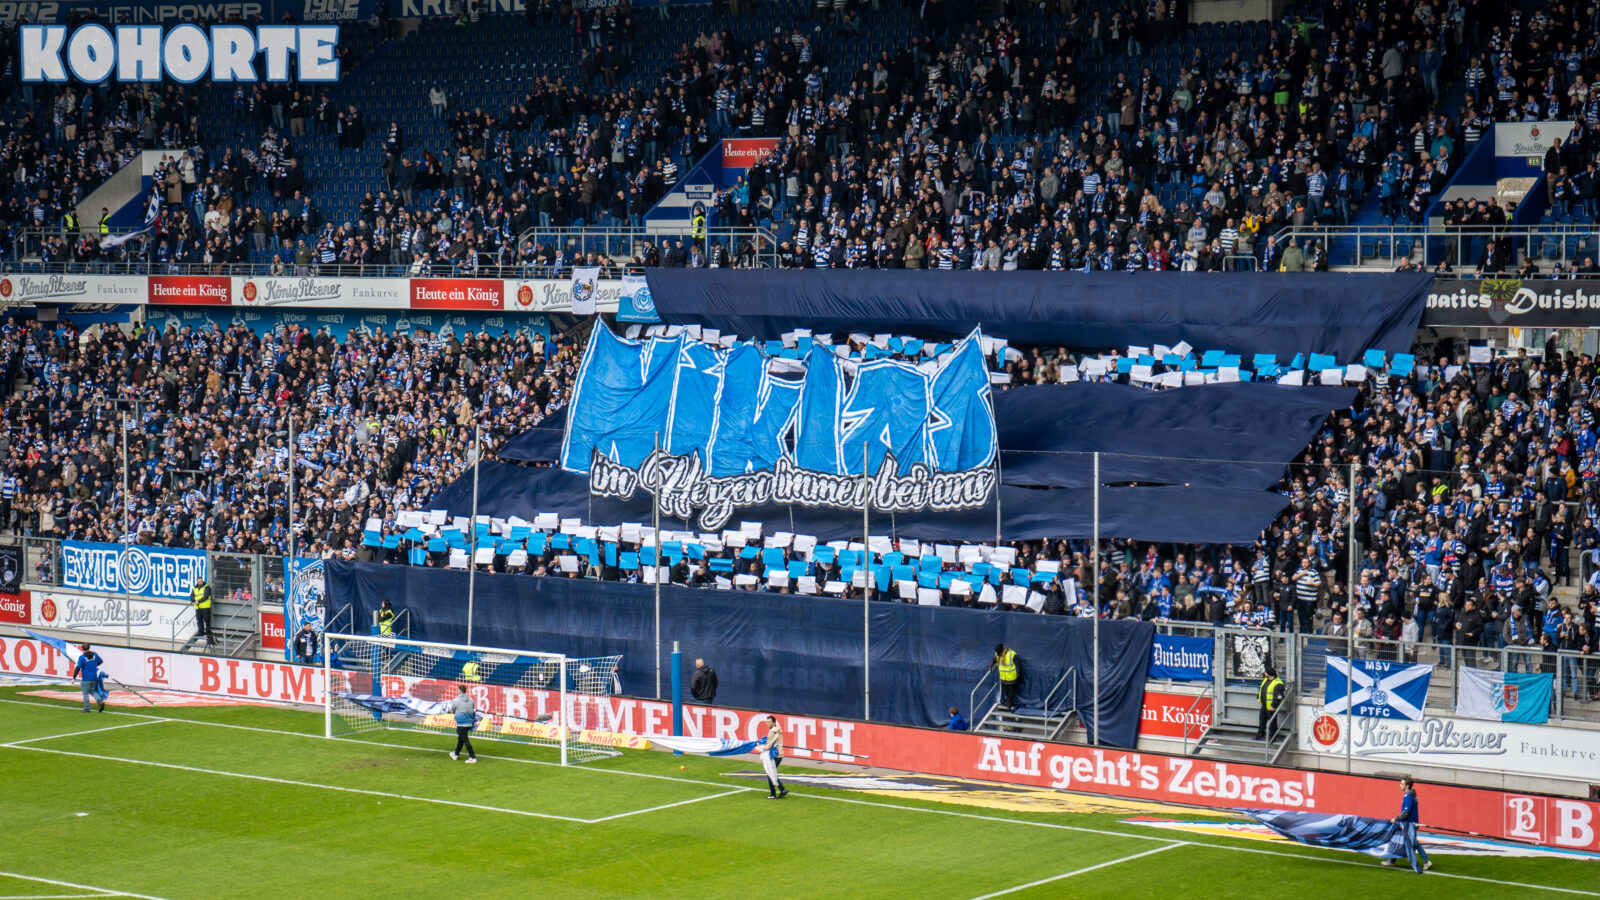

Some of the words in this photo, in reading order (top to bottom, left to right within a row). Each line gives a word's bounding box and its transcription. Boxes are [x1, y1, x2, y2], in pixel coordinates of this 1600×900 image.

[317, 12, 334, 21] SIND
[724, 147, 746, 157] Heute
[747, 147, 758, 157] ein
[18, 277, 49, 298] König
[48, 275, 87, 293] Pilsener
[97, 285, 139, 295] Fankurve
[153, 283, 181, 296] Heute
[182, 285, 197, 296] ein
[199, 284, 228, 302] König
[264, 280, 299, 301] König
[298, 278, 341, 297] Pilsener
[352, 288, 399, 298] Fankurve
[415, 286, 447, 301] Heute
[449, 288, 467, 301] ein
[469, 288, 500, 307] König
[591, 449, 639, 500] im
[638, 447, 776, 531] Herzen
[775, 454, 876, 509] immer
[874, 450, 931, 511] bei
[930, 467, 995, 509] uns
[63, 546, 119, 591] EWIG
[65, 598, 104, 626] König
[1153, 643, 1210, 674] Duisburg
[1365, 660, 1391, 673] MSV
[1162, 705, 1210, 733] König
[1360, 705, 1391, 718] PTFC
[507, 721, 544, 737] Sinalco
[586, 731, 623, 746] Sinalco
[1354, 715, 1421, 753] König
[1421, 717, 1507, 749] Pilsener
[1520, 741, 1597, 760] Fankurve
[978, 738, 1046, 776] Auf
[1049, 749, 1160, 789] geht's
[1168, 757, 1316, 808] Zebras!
